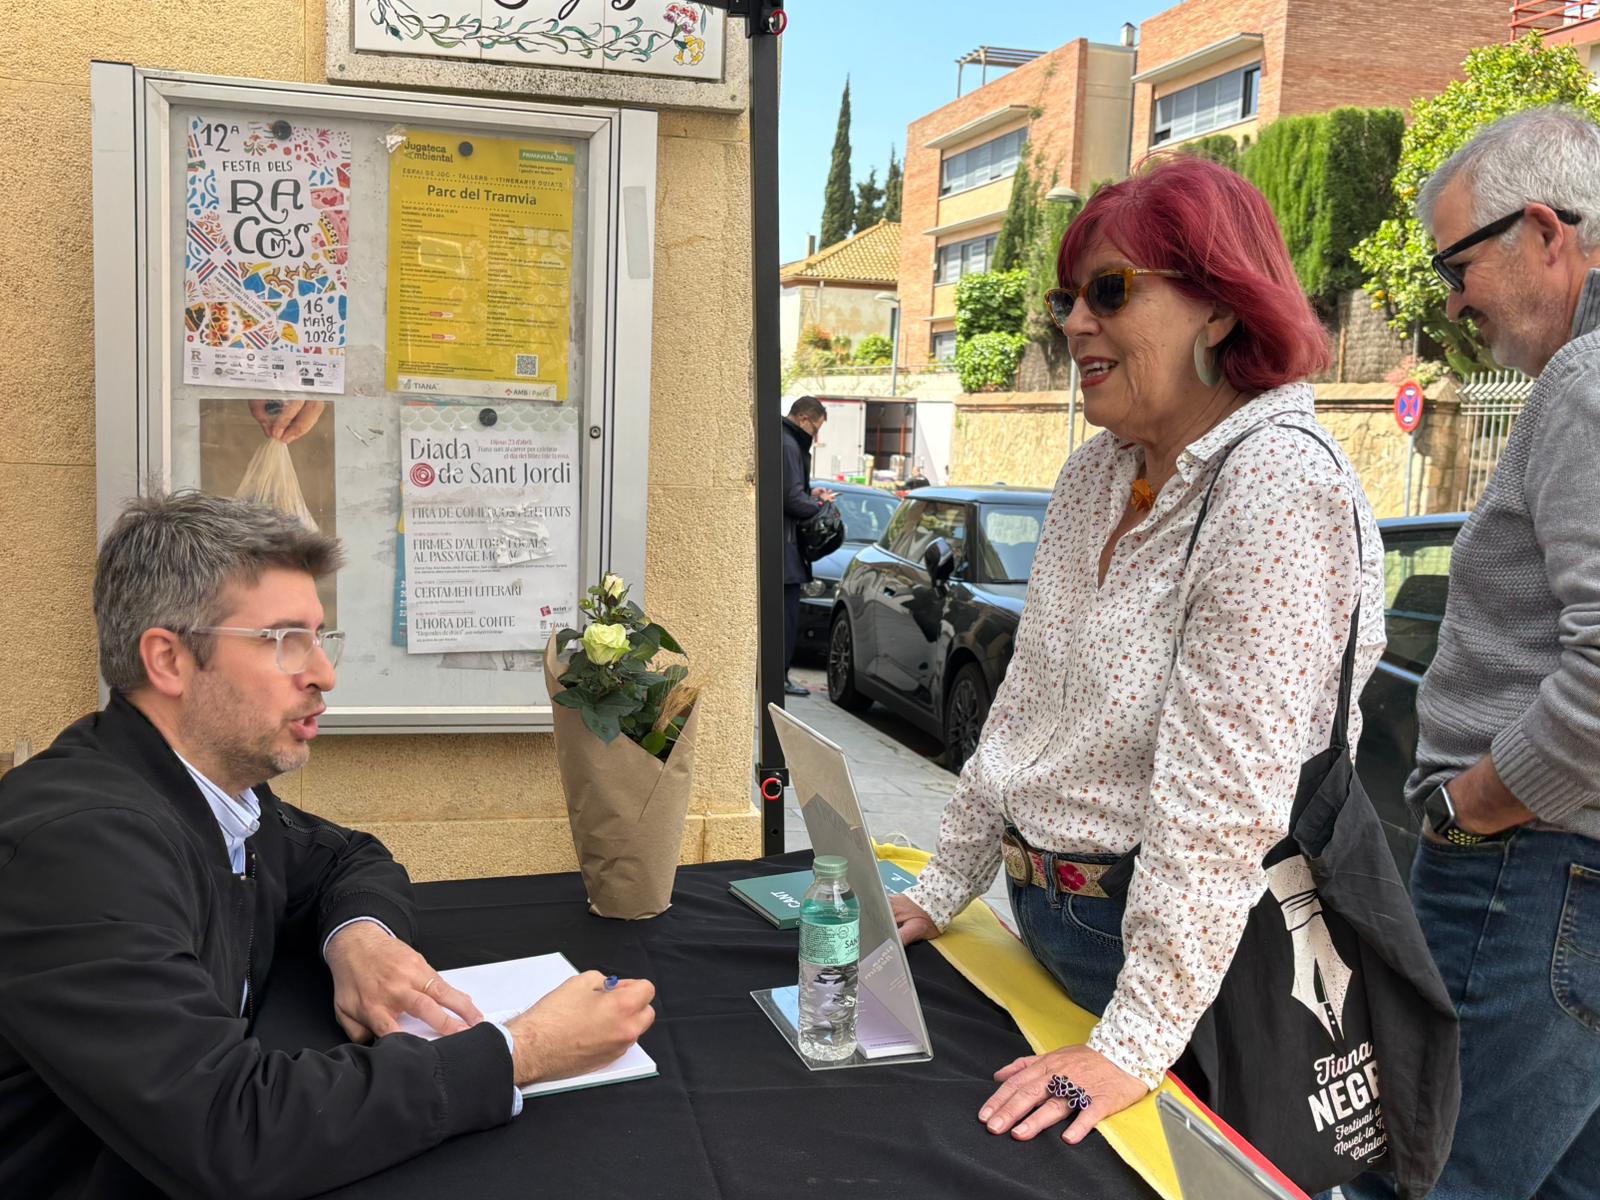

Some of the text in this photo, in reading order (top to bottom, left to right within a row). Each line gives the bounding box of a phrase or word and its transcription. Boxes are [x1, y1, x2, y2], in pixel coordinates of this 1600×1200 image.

[404, 141, 447, 153] Jugateca
[222, 160, 293, 172] FESTA DELS
[427, 184, 537, 206] Parc del Tramvia
[227, 179, 304, 225] RA
[304, 297, 323, 314] 16
[305, 331, 336, 343] 2026
[414, 383, 437, 391] TIANA
[410, 438, 471, 460] Diada
[438, 462, 571, 487] de Sant Jordi
[412, 507, 436, 518] FIRA
[438, 507, 454, 518] DE
[414, 539, 452, 550] FIRMES
[414, 552, 428, 562] AL
[430, 551, 480, 562] PASSATGE
[414, 585, 522, 598] CERTAMEN LITERARI
[416, 616, 516, 630] L'HORA DEL CONTE
[1314, 1040, 1374, 1085] Tiana
[1335, 1109, 1374, 1140] Festival
